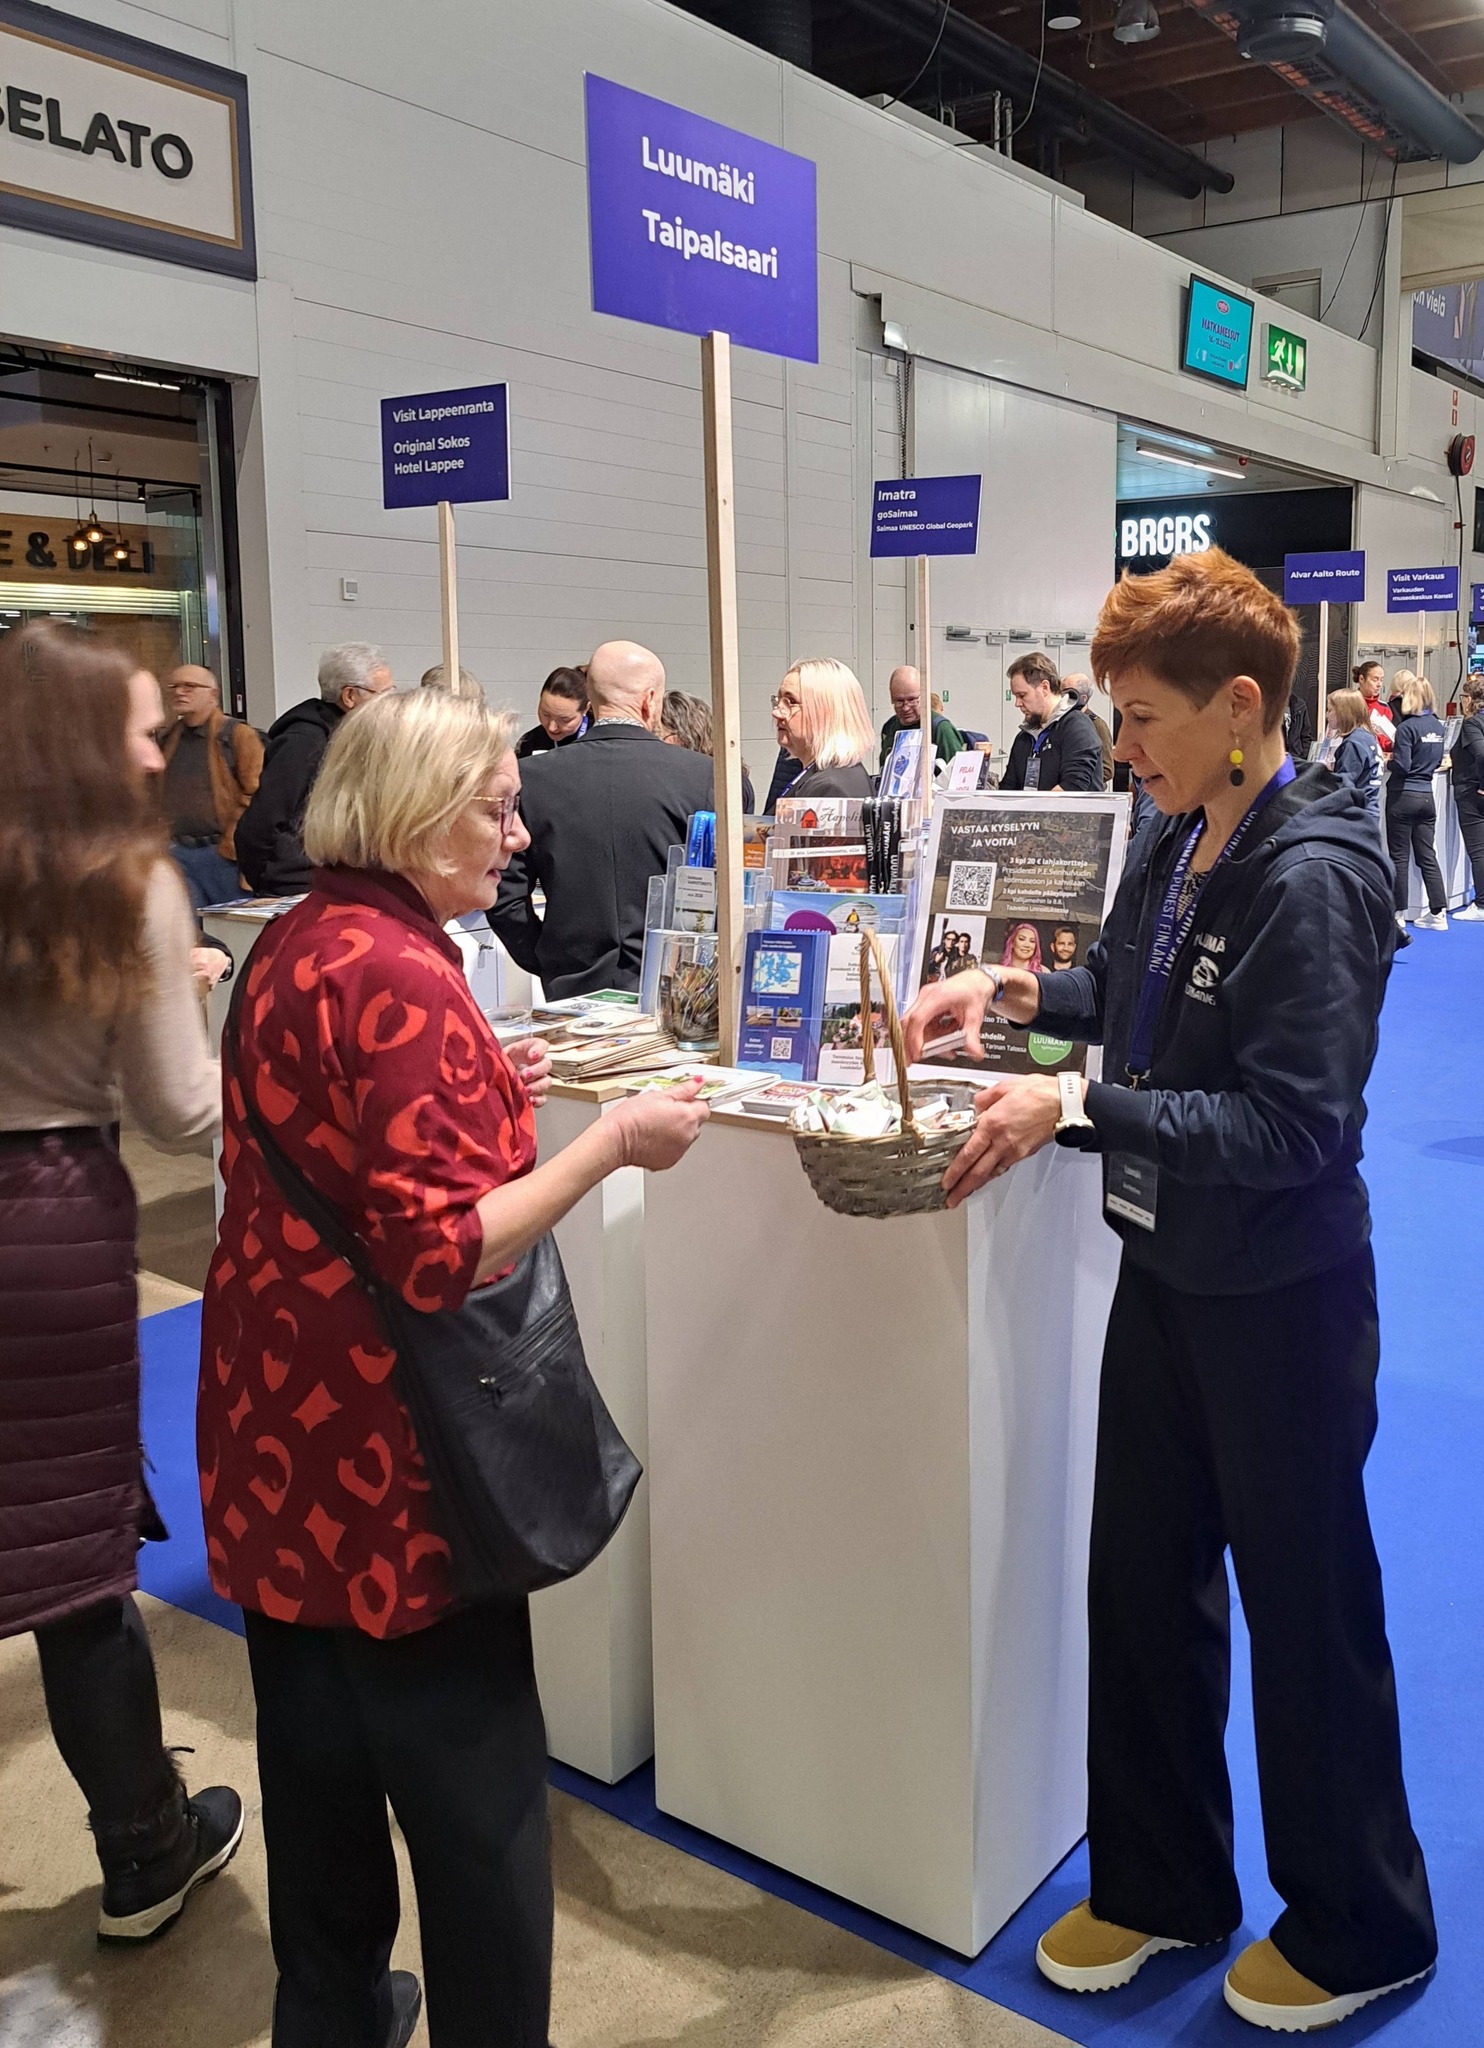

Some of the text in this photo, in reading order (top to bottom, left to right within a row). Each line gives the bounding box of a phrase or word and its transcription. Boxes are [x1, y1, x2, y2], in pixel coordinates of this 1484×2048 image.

[0, 85, 193, 179] ELATO
[642, 136, 755, 205] Luumäki
[642, 208, 778, 279] Taipalsaari
[1426, 289, 1446, 318] vielä
[392, 400, 495, 423] Visit Lappeenranta
[393, 435, 471, 455] Original Sokos
[394, 459, 465, 475] Hotel Lappee
[878, 490, 917, 501] Imatra
[877, 509, 918, 521] goSaimaa
[899, 523, 925, 531] UNESCO
[926, 522, 946, 530] Global
[946, 521, 974, 530] Geopark
[1121, 514, 1211, 557] BRGRS
[1290, 569, 1360, 579] Alvar Aalto Route
[1392, 573, 1445, 582] Visit Varkaus
[959, 766, 975, 774] PELAA
[951, 822, 1040, 835] VASTAA KYSELYYN
[971, 837, 1017, 848] JA VOITA!
[1015, 857, 1026, 866] kpl
[1162, 876, 1183, 921] PUREST
